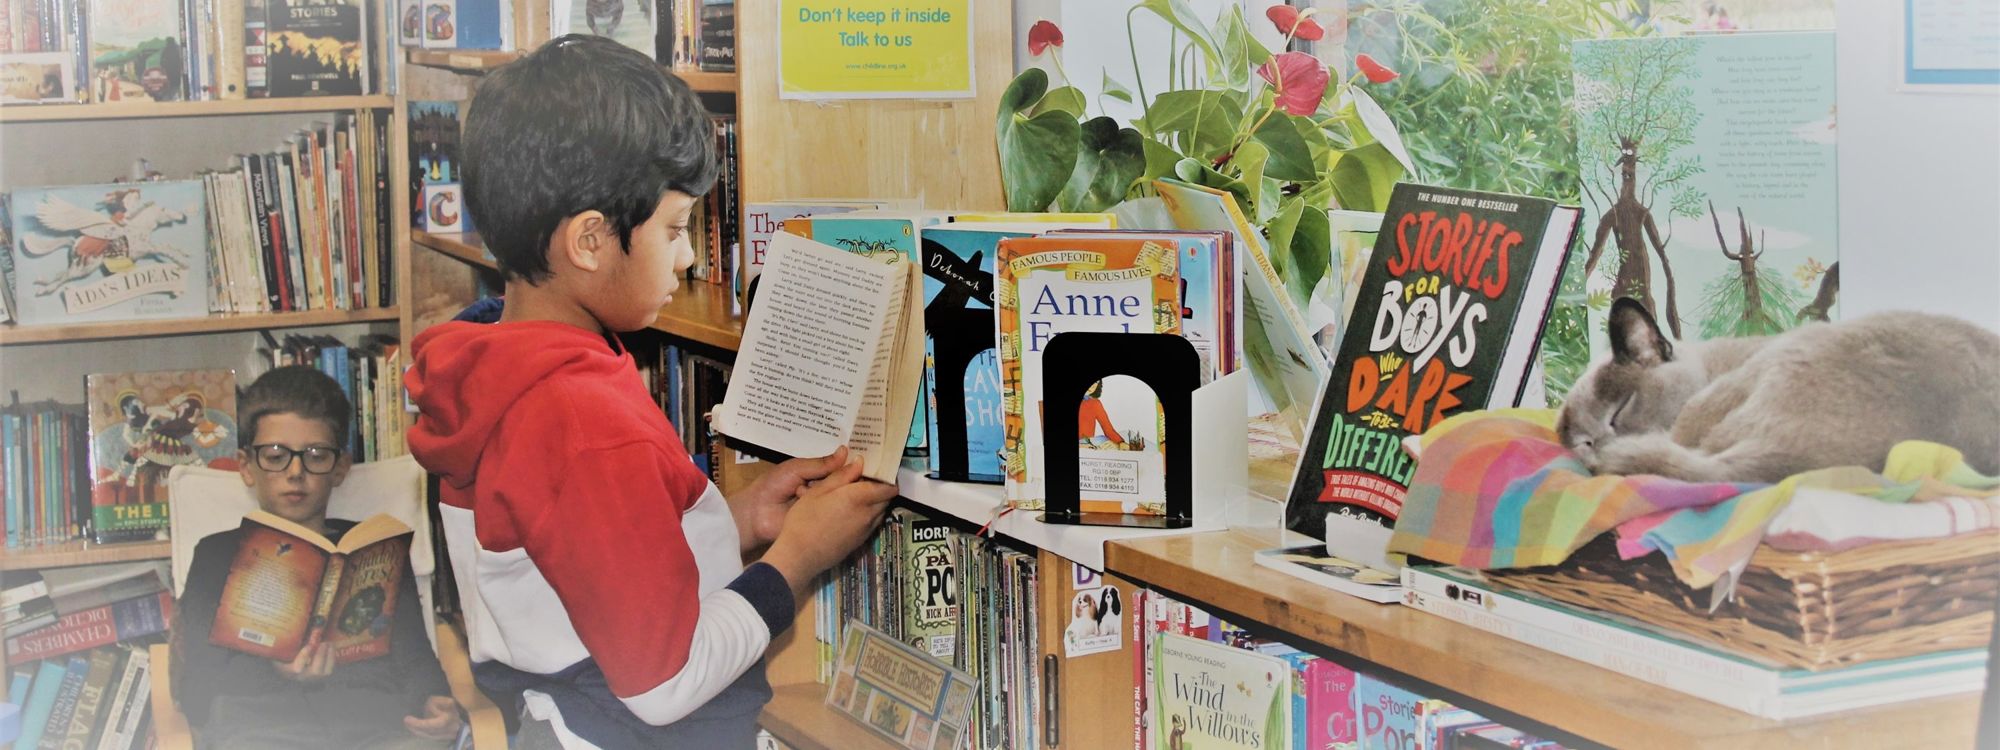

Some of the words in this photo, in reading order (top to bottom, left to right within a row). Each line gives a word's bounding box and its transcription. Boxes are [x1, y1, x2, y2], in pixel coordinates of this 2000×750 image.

[290, 7, 338, 18] STORIES
[799, 8, 843, 22] Don't
[847, 8, 886, 25] keep
[891, 8, 902, 22] it
[905, 8, 951, 23] inside
[838, 32, 869, 46] Talk
[874, 33, 889, 46] to
[894, 35, 912, 46] us
[1417, 192, 1430, 201] THE
[1431, 193, 1459, 205] NUMBER
[1461, 197, 1476, 207] ONE
[1478, 199, 1519, 212] BESTSELLER
[750, 212, 785, 234] The
[1011, 253, 1059, 271] FAMOUS
[1061, 252, 1102, 264] PEOPLE
[930, 252, 979, 292] Deborah
[1074, 271, 1121, 281] FAMOUS
[1123, 267, 1152, 280] LIVES
[1405, 275, 1440, 303] FOR
[1030, 284, 1140, 318] Anne
[1369, 280, 1488, 375] BOYS
[979, 350, 997, 367] TH
[1347, 355, 1473, 434] DARE
[1323, 413, 1418, 487] DIFFERE
[113, 504, 152, 519] THE
[926, 607, 942, 619] NICK
[23, 622, 112, 656] CHAMBERS
[1199, 671, 1217, 688] The
[1324, 680, 1346, 693] The
[1174, 672, 1225, 712] Wind
[1379, 694, 1416, 721] Storie
[1134, 716, 1141, 725] IN
[1187, 705, 1260, 749] Willows
[1226, 711, 1238, 724] in
[1239, 713, 1256, 727] the
[1327, 711, 1356, 740] Cr
